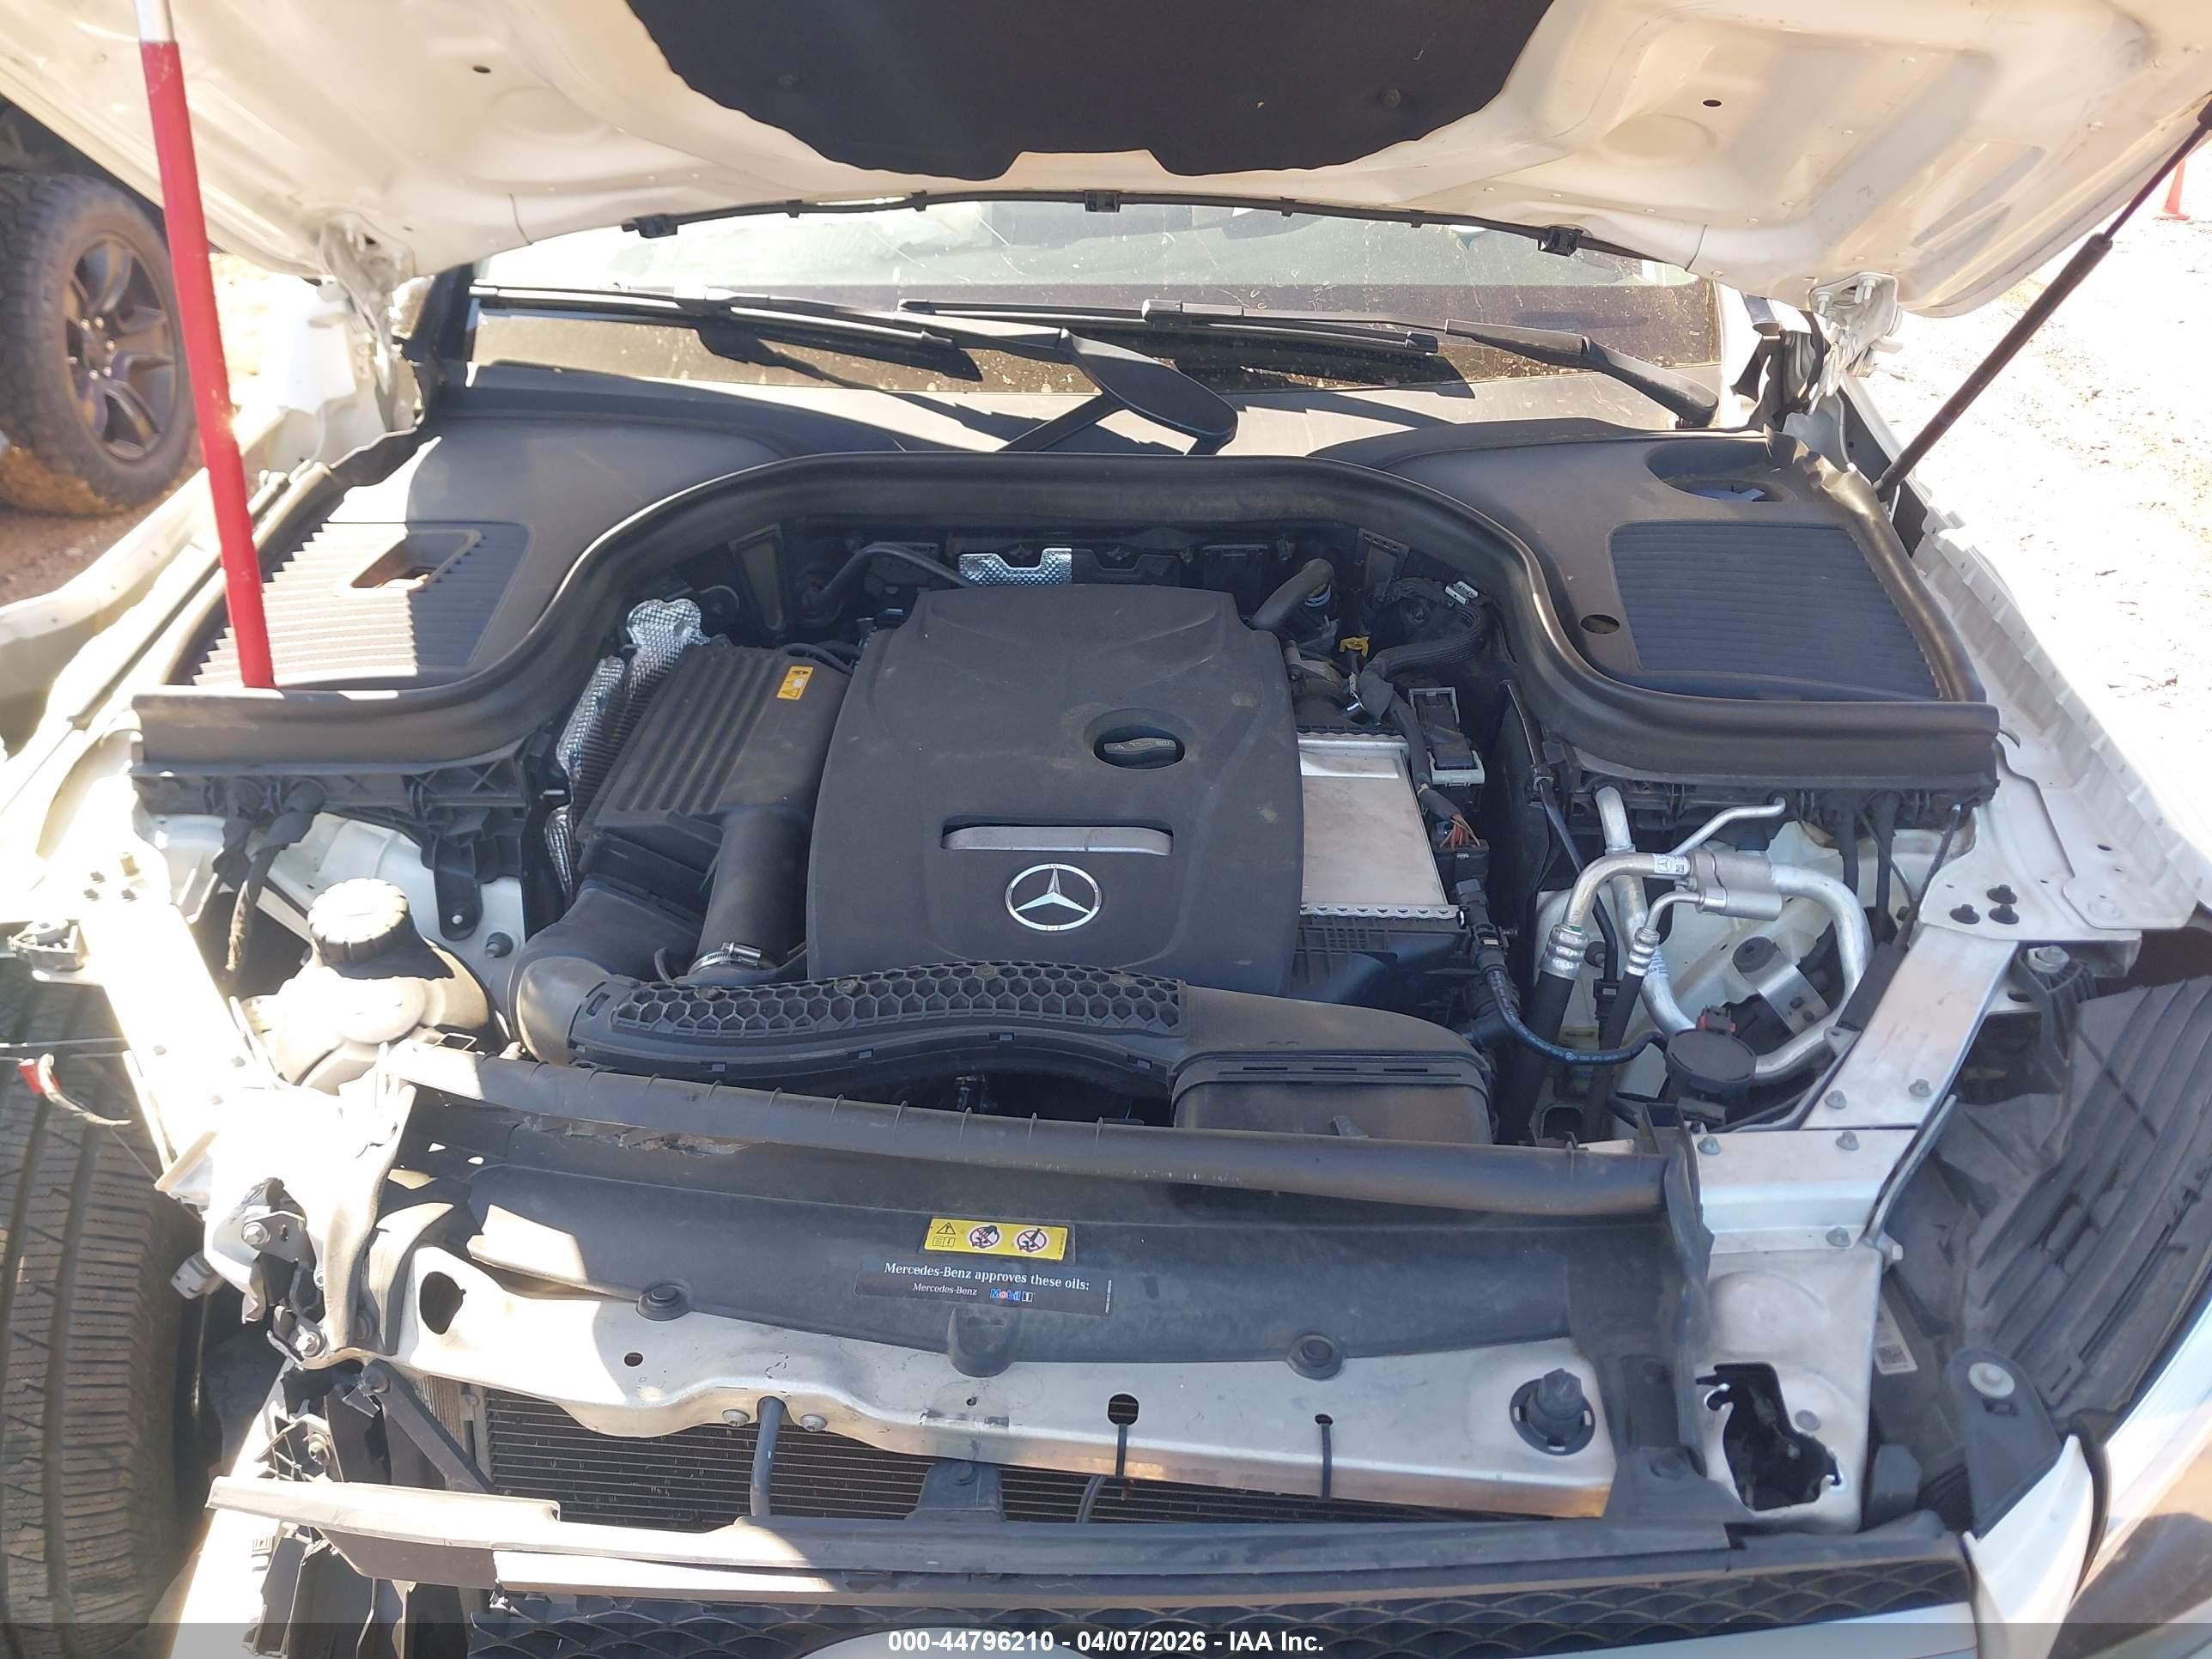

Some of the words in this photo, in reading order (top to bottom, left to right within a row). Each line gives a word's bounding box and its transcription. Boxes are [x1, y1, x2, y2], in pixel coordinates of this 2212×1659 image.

[884, 1262, 972, 1279] Mercedes-Benz
[975, 1271, 1027, 1284] approves
[1030, 1273, 1063, 1287] these
[1065, 1277, 1090, 1291] oils:
[913, 1282, 977, 1296] Mercedes-Benz
[989, 1288, 1018, 1301] Mobil
